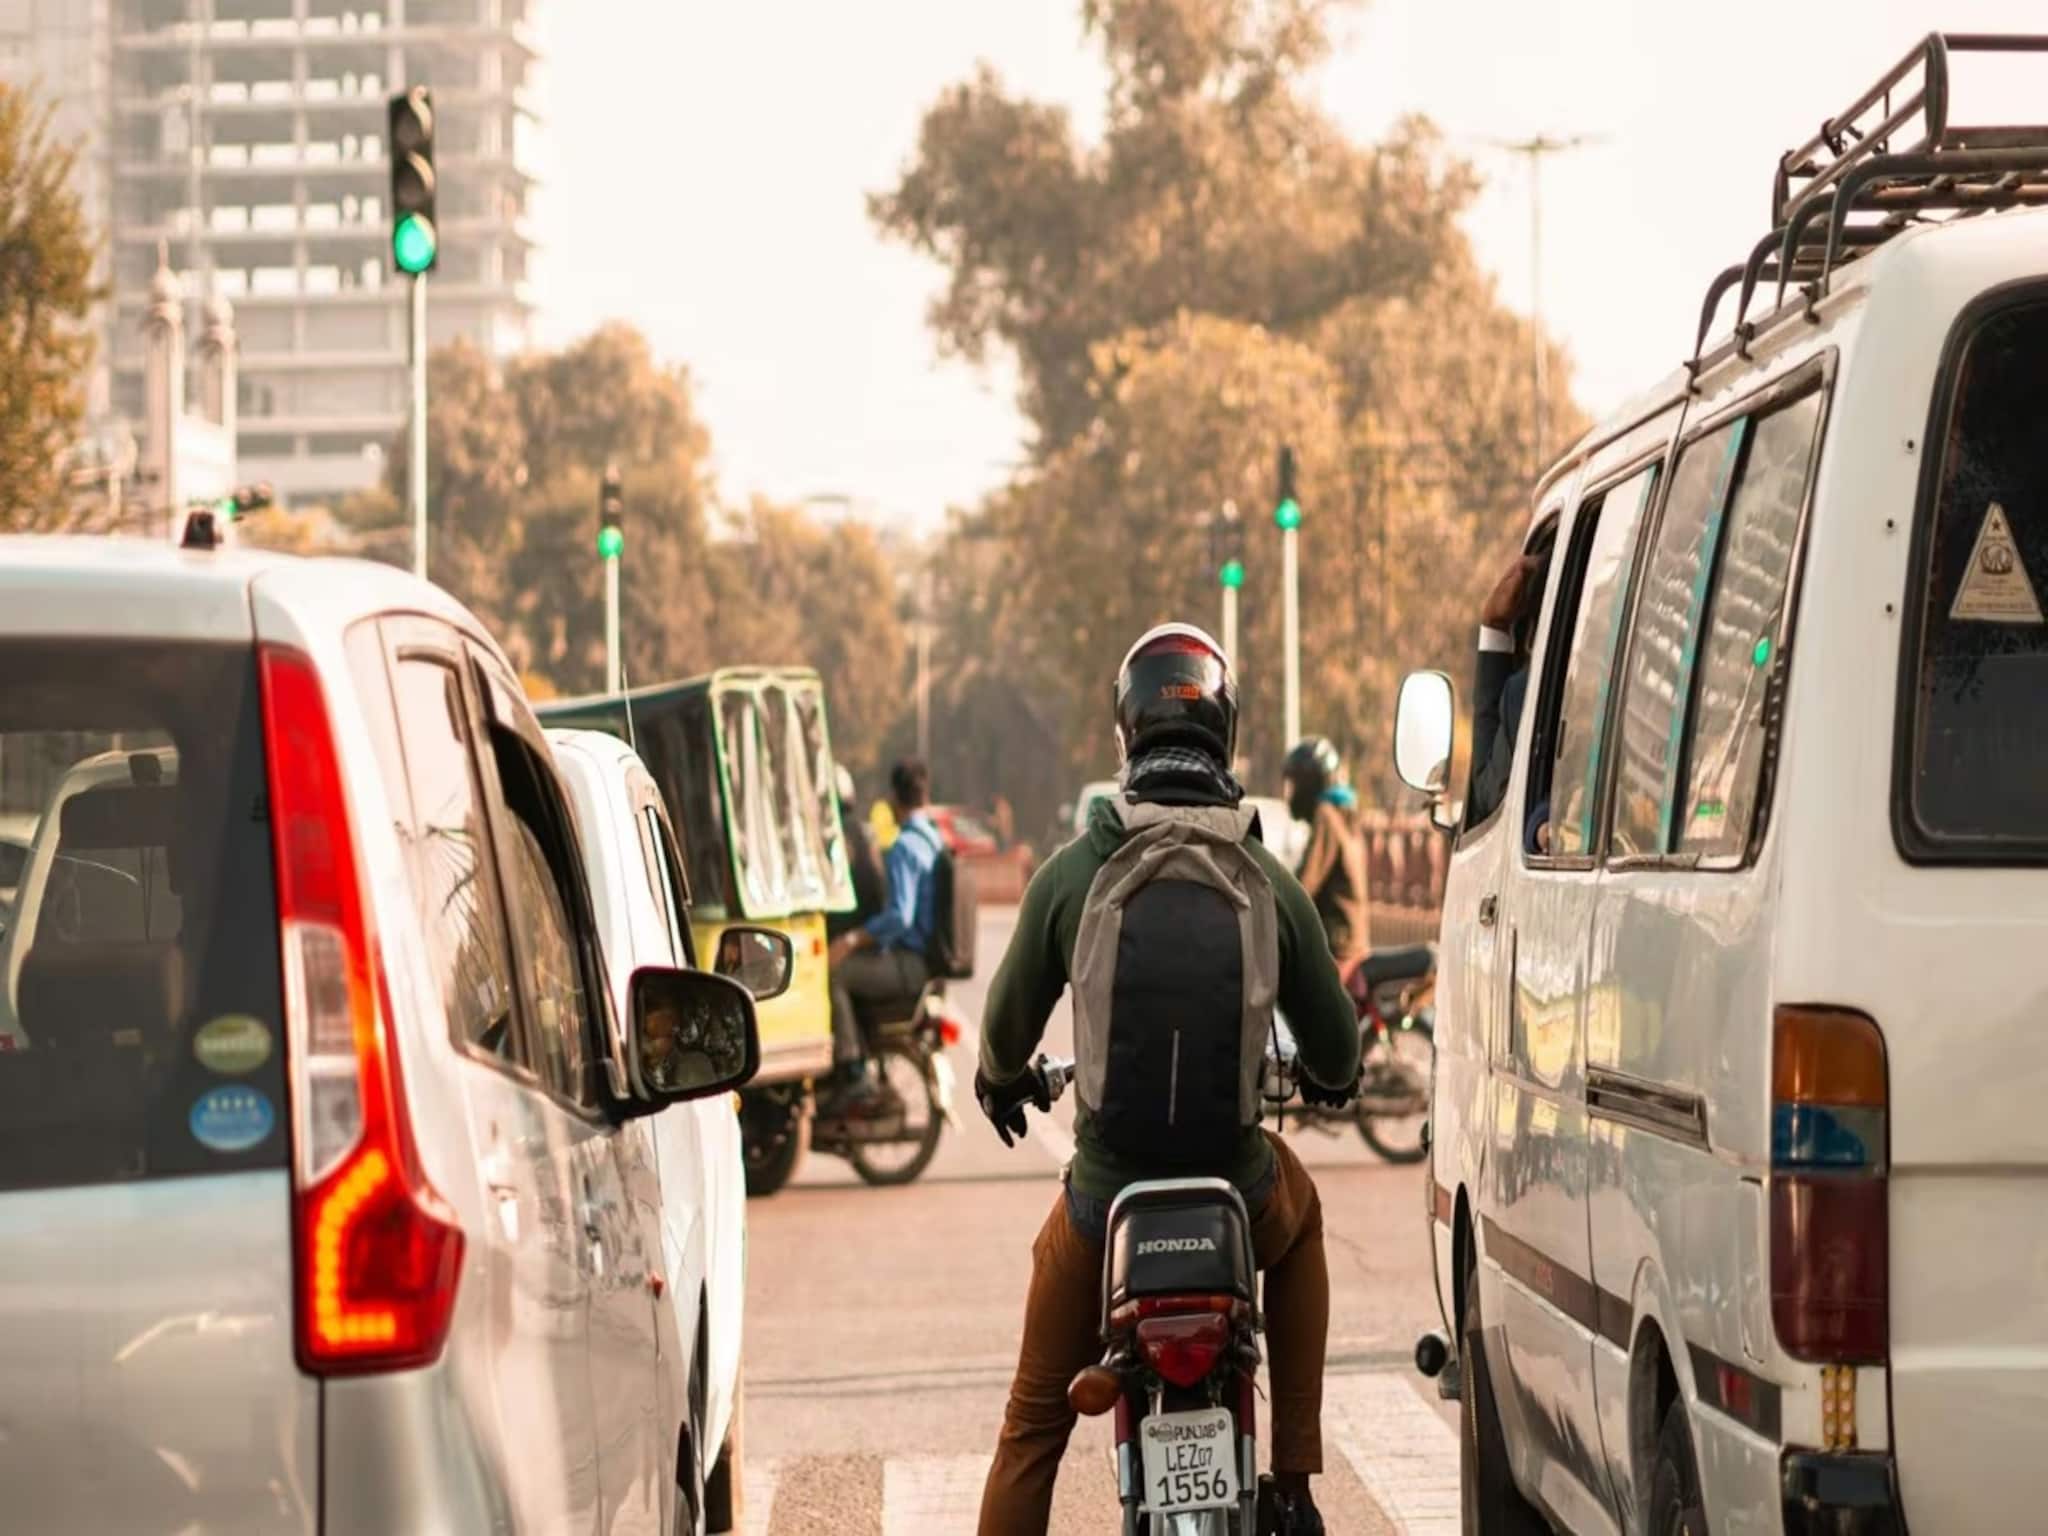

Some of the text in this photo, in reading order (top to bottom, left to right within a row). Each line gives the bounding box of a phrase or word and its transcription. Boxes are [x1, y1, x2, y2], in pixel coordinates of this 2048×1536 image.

[1136, 1237, 1217, 1256] HONDA
[1174, 1423, 1217, 1441] PUNJAB
[1156, 1468, 1228, 1507] 1556
